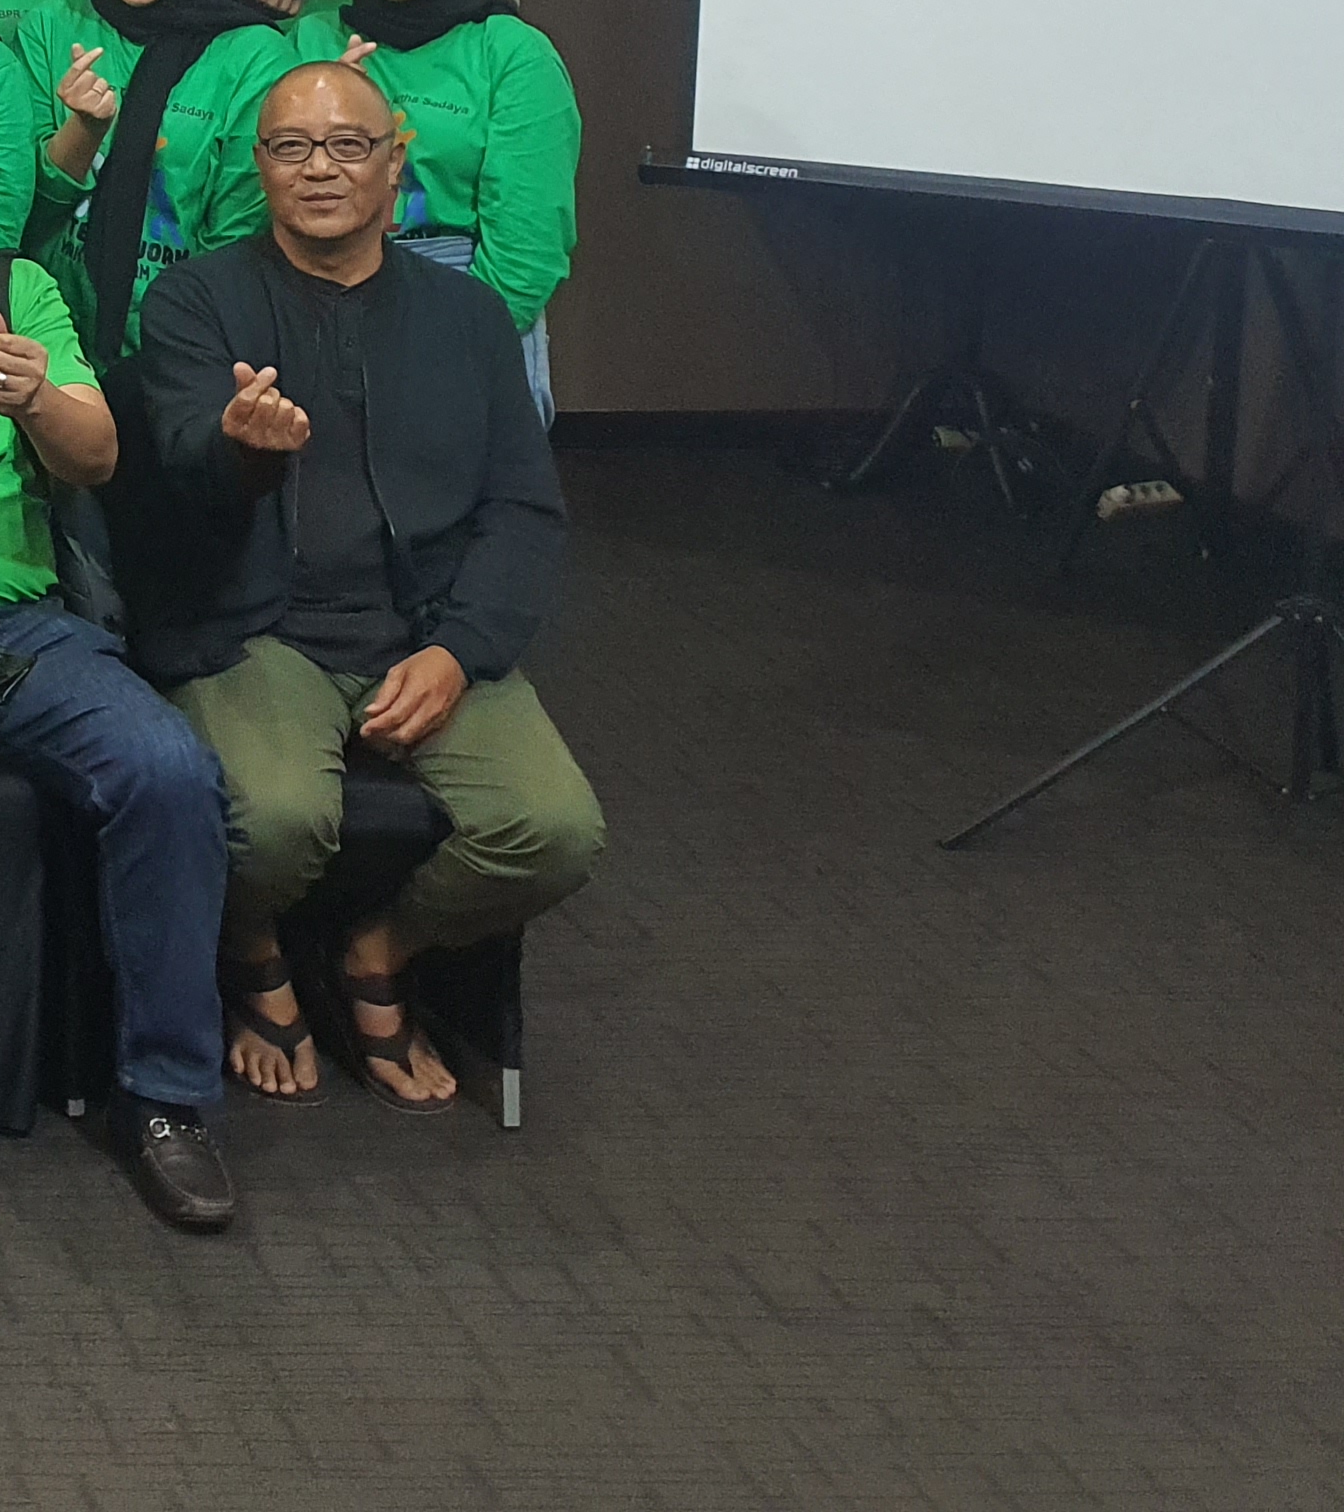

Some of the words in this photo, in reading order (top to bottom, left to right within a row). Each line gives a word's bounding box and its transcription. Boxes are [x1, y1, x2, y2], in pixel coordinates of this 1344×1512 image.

[171, 102, 215, 121] Sadaya
[423, 96, 470, 115] Sadaya
[701, 158, 799, 178] digitalscreen
